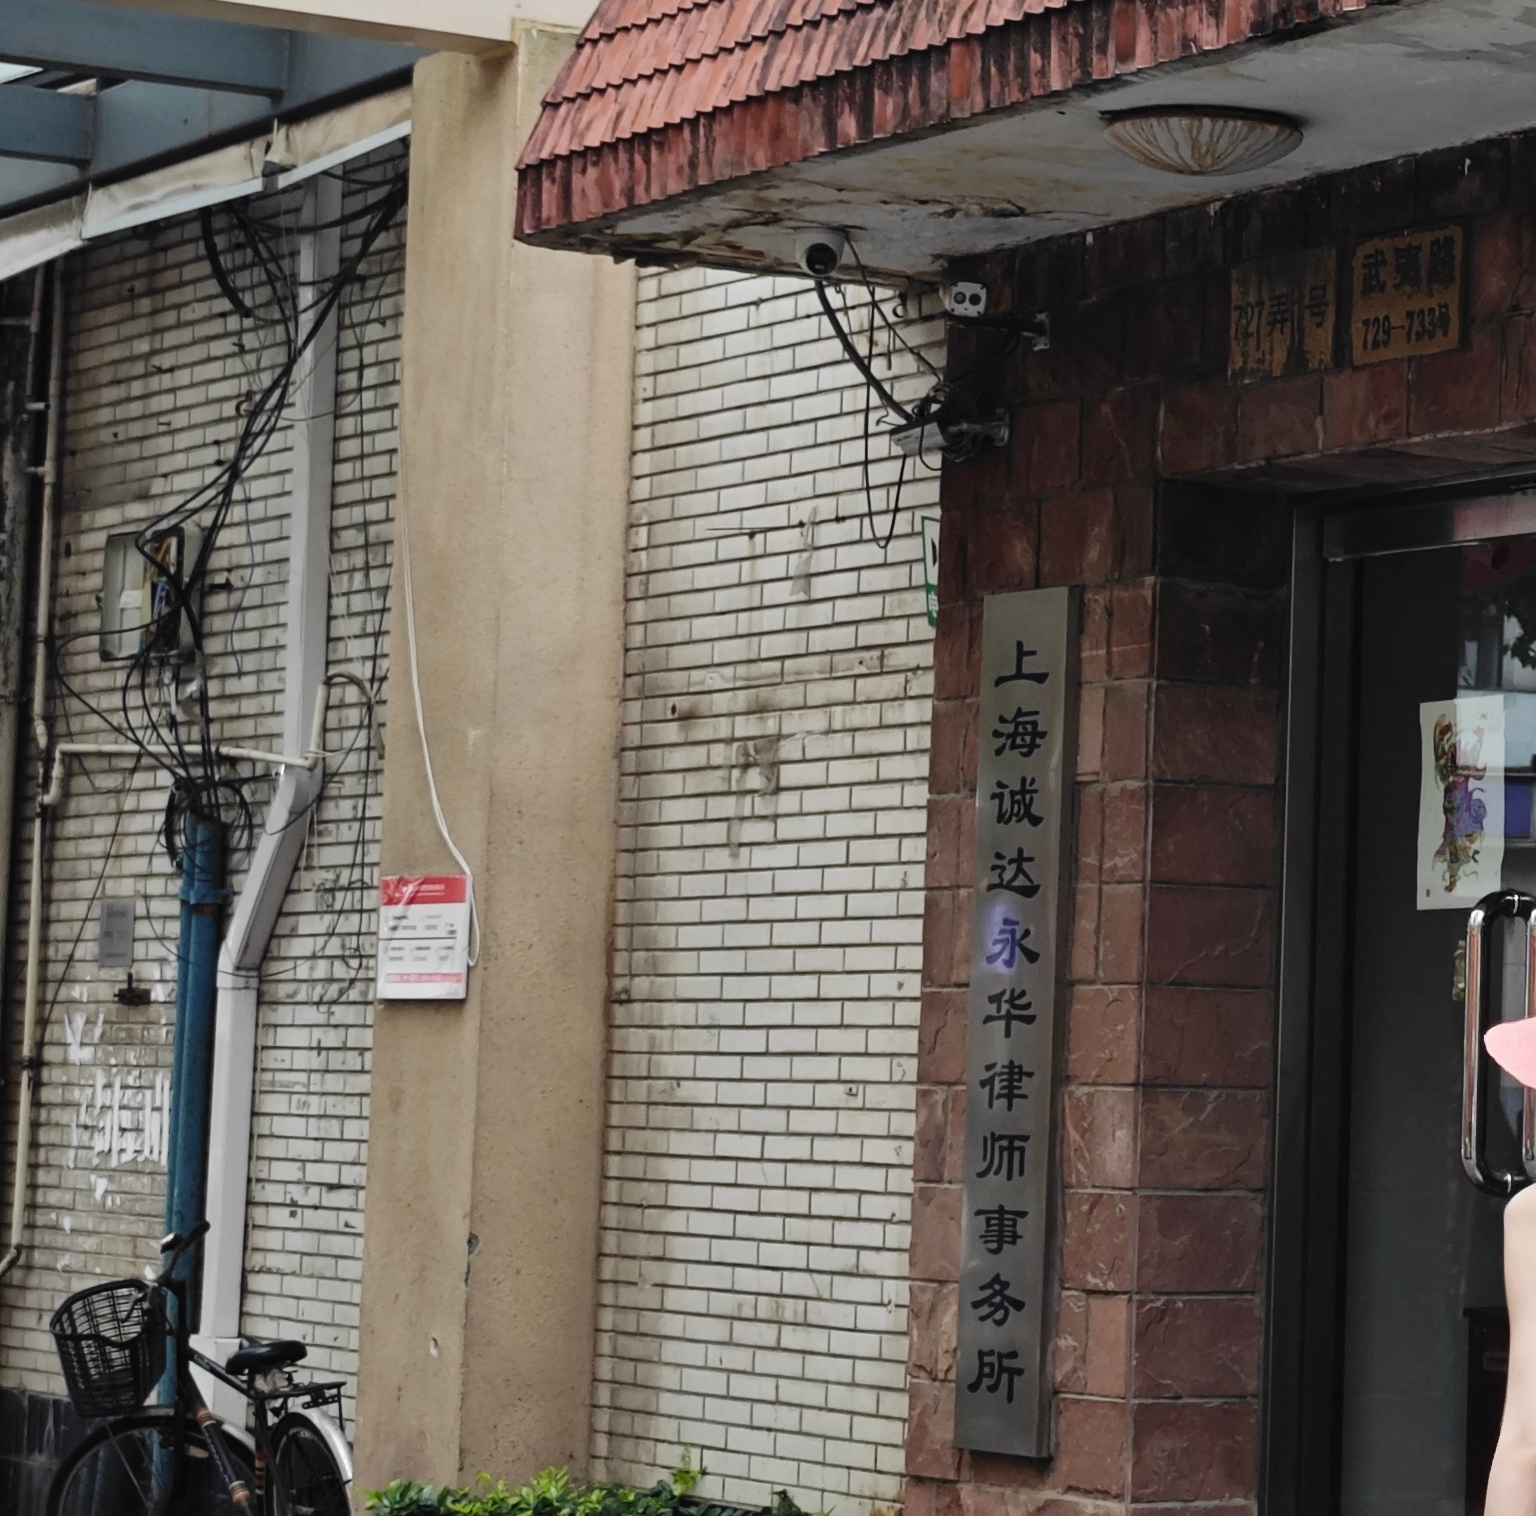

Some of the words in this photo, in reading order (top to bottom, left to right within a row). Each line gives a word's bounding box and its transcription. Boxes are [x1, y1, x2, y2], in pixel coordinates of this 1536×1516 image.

[1361, 236, 1456, 299] 武夷路
[967, 639, 1051, 1405] 上海诚达永华律师事务所
